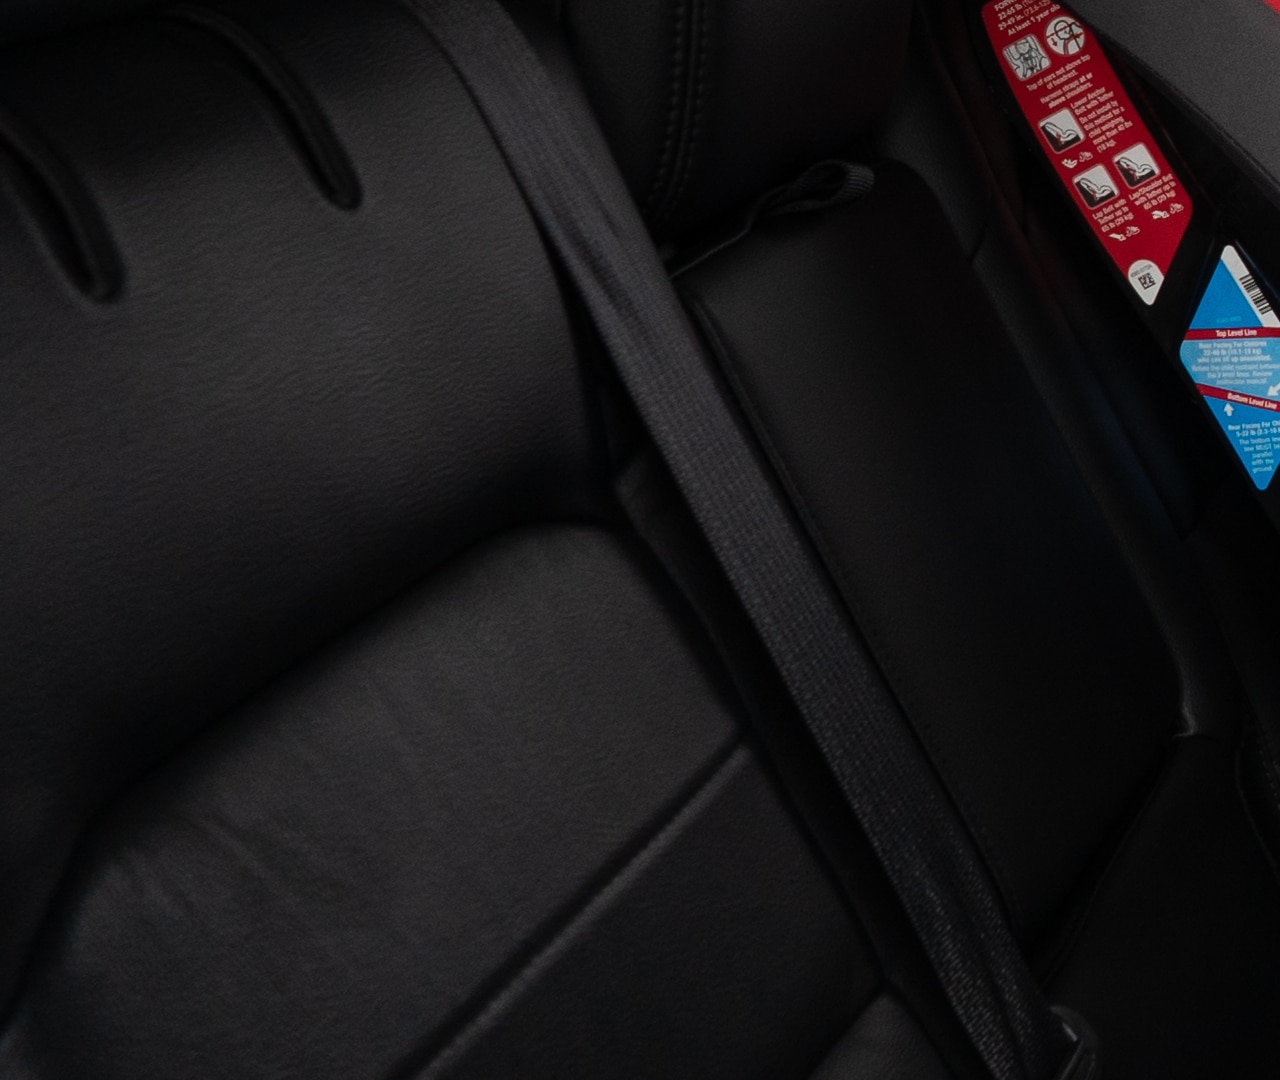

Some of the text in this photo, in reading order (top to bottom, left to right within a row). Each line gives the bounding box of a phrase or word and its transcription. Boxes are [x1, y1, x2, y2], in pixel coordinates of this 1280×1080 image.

[1006, 27, 1016, 36] At
[1014, 18, 1031, 31] least
[1029, 15, 1036, 23] 1
[1034, 9, 1051, 22] year
[1215, 329, 1226, 338] Top
[1227, 328, 1243, 336] Level
[1226, 391, 1277, 409] Bottom Level Line
